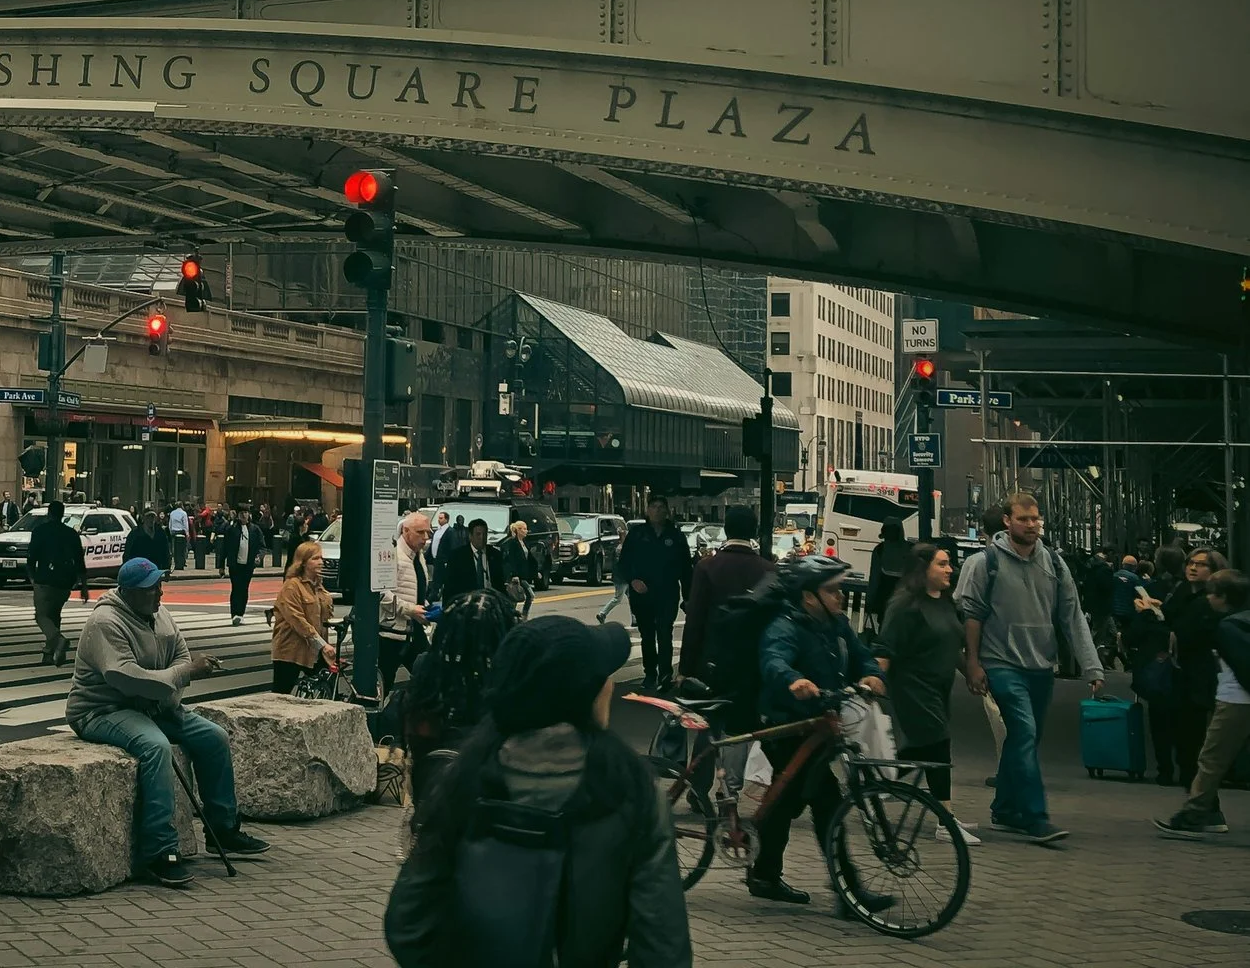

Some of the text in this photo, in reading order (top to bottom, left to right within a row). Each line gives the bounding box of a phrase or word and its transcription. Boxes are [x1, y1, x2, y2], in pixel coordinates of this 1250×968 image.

[249, 58, 540, 114] SQUARE
[604, 85, 876, 155] PLAZA
[912, 326, 926, 336] NO
[905, 338, 936, 348] TURNS
[4, 392, 20, 400] Park
[950, 394, 976, 403] Park
[86, 543, 126, 555] POLICE
